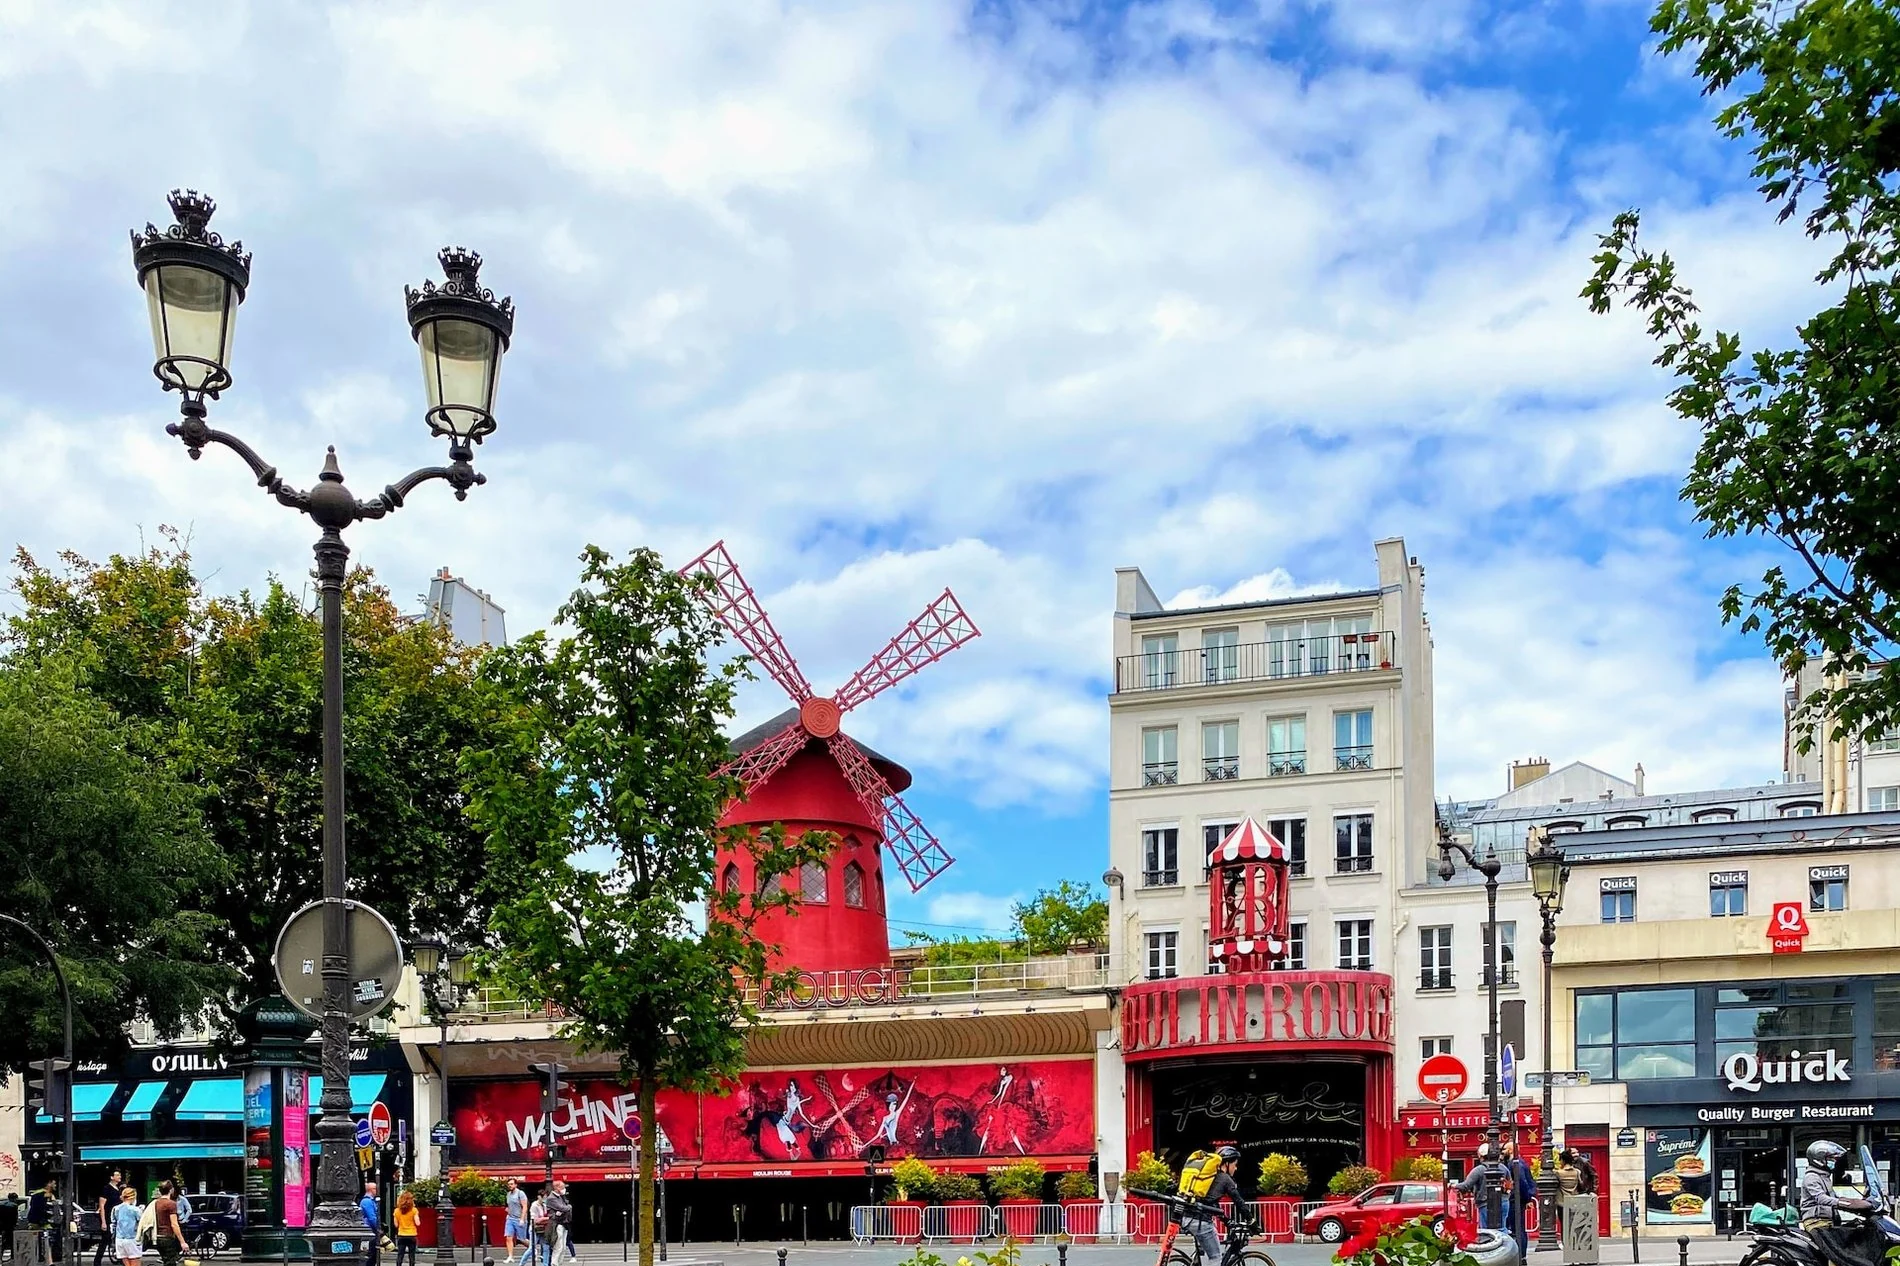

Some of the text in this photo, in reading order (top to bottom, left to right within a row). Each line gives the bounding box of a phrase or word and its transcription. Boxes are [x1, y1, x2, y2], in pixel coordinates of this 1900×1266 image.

[1711, 871, 1746, 884] Quick
[1811, 866, 1847, 879] Quick
[1601, 878, 1636, 890] Quick
[1777, 906, 1802, 931] Q
[1774, 938, 1801, 948] Quick
[758, 968, 913, 1009] ROUGE
[1123, 981, 1392, 1050] OULIN ROUG
[1724, 1049, 1852, 1092] Quick
[1698, 1104, 1874, 1121] Quality Burger Restaurant
[1433, 1116, 1487, 1127] BLLETTE
